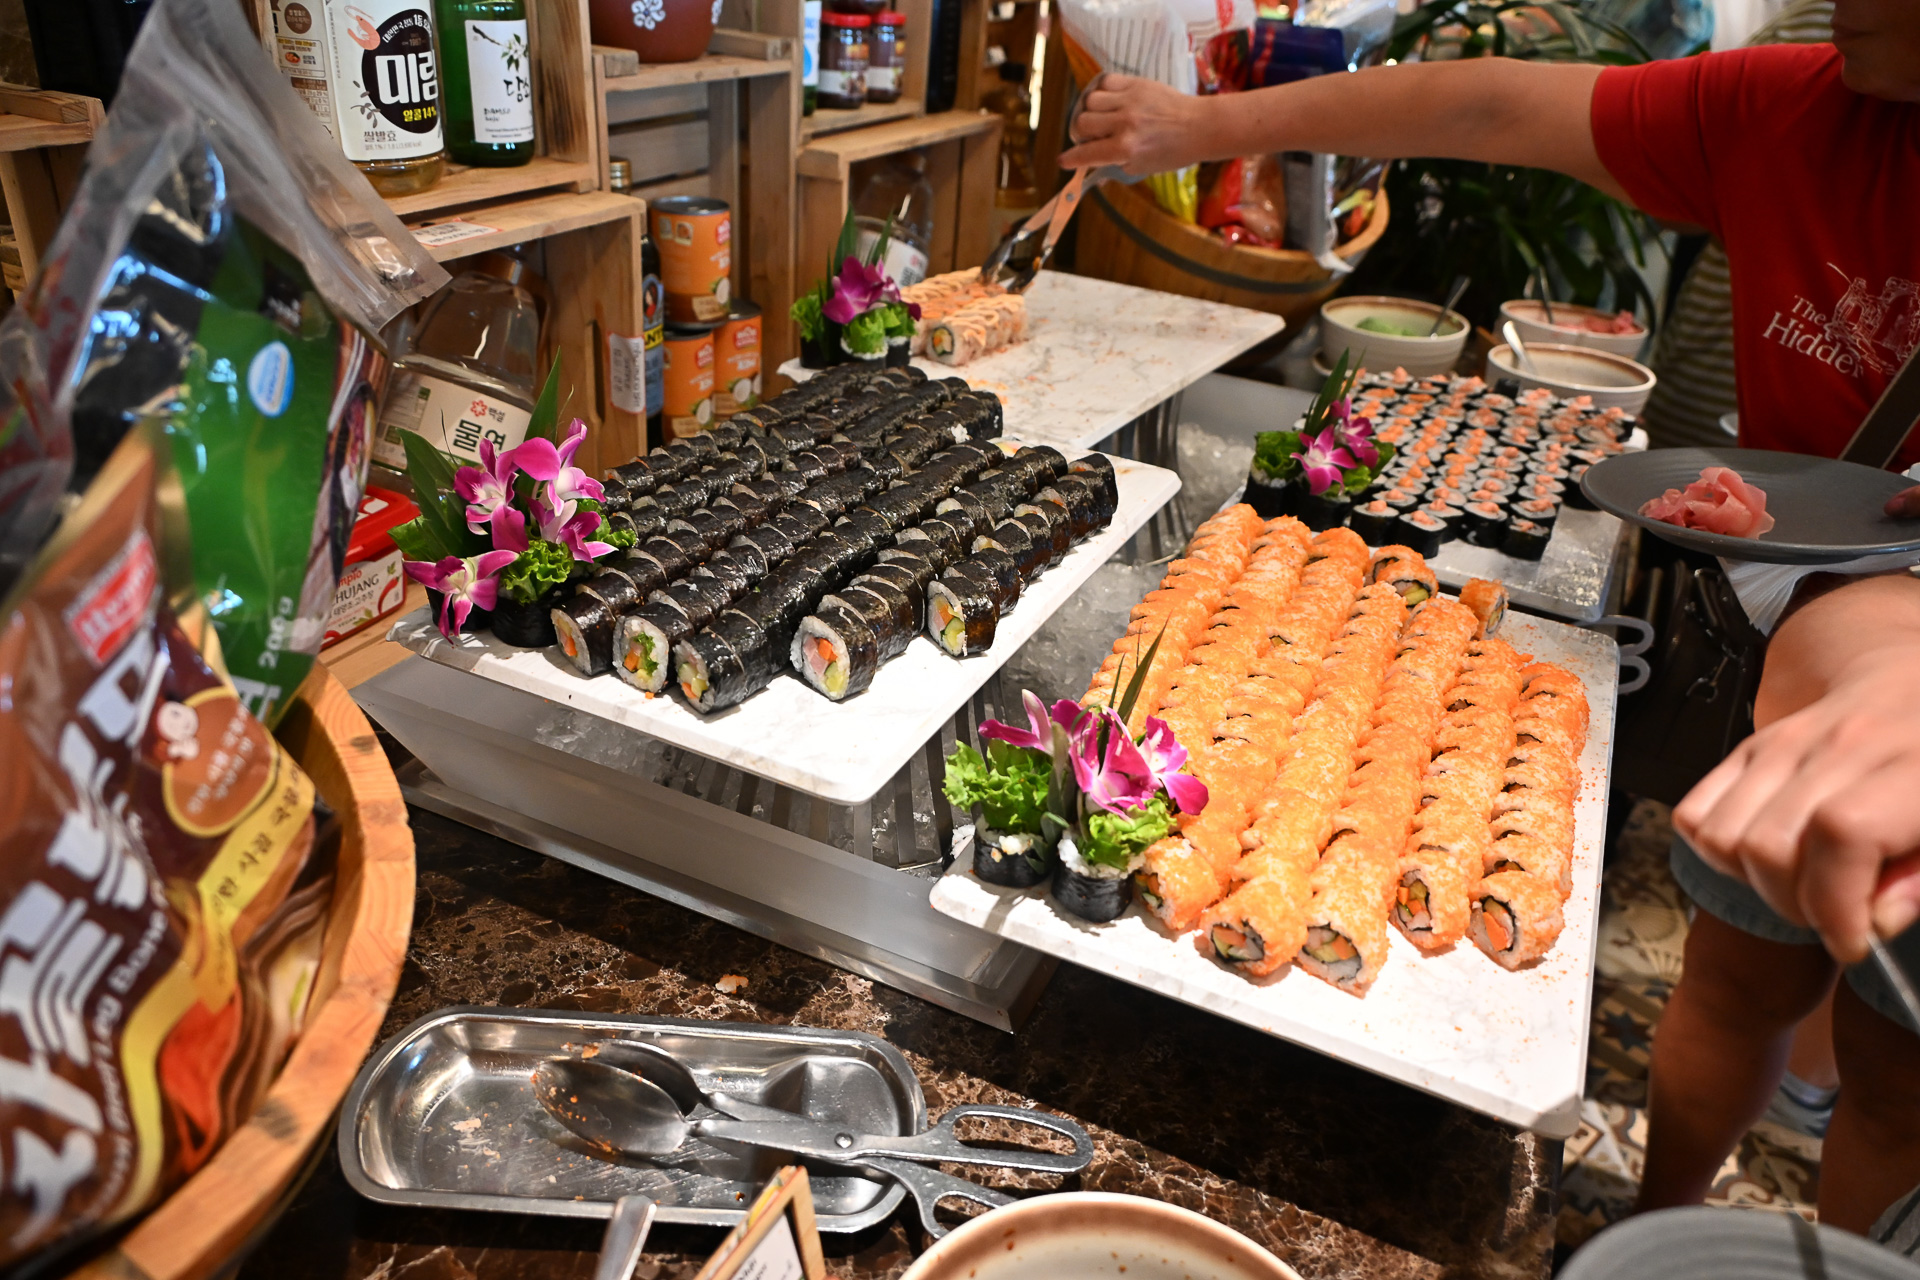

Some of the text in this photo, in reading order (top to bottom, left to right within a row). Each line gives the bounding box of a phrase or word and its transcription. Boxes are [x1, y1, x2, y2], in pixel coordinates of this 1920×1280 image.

[375, 50, 438, 104] 미림
[1792, 295, 1827, 325] The
[258, 596, 294, 669] 200g
[236, 829, 275, 877] 사골
